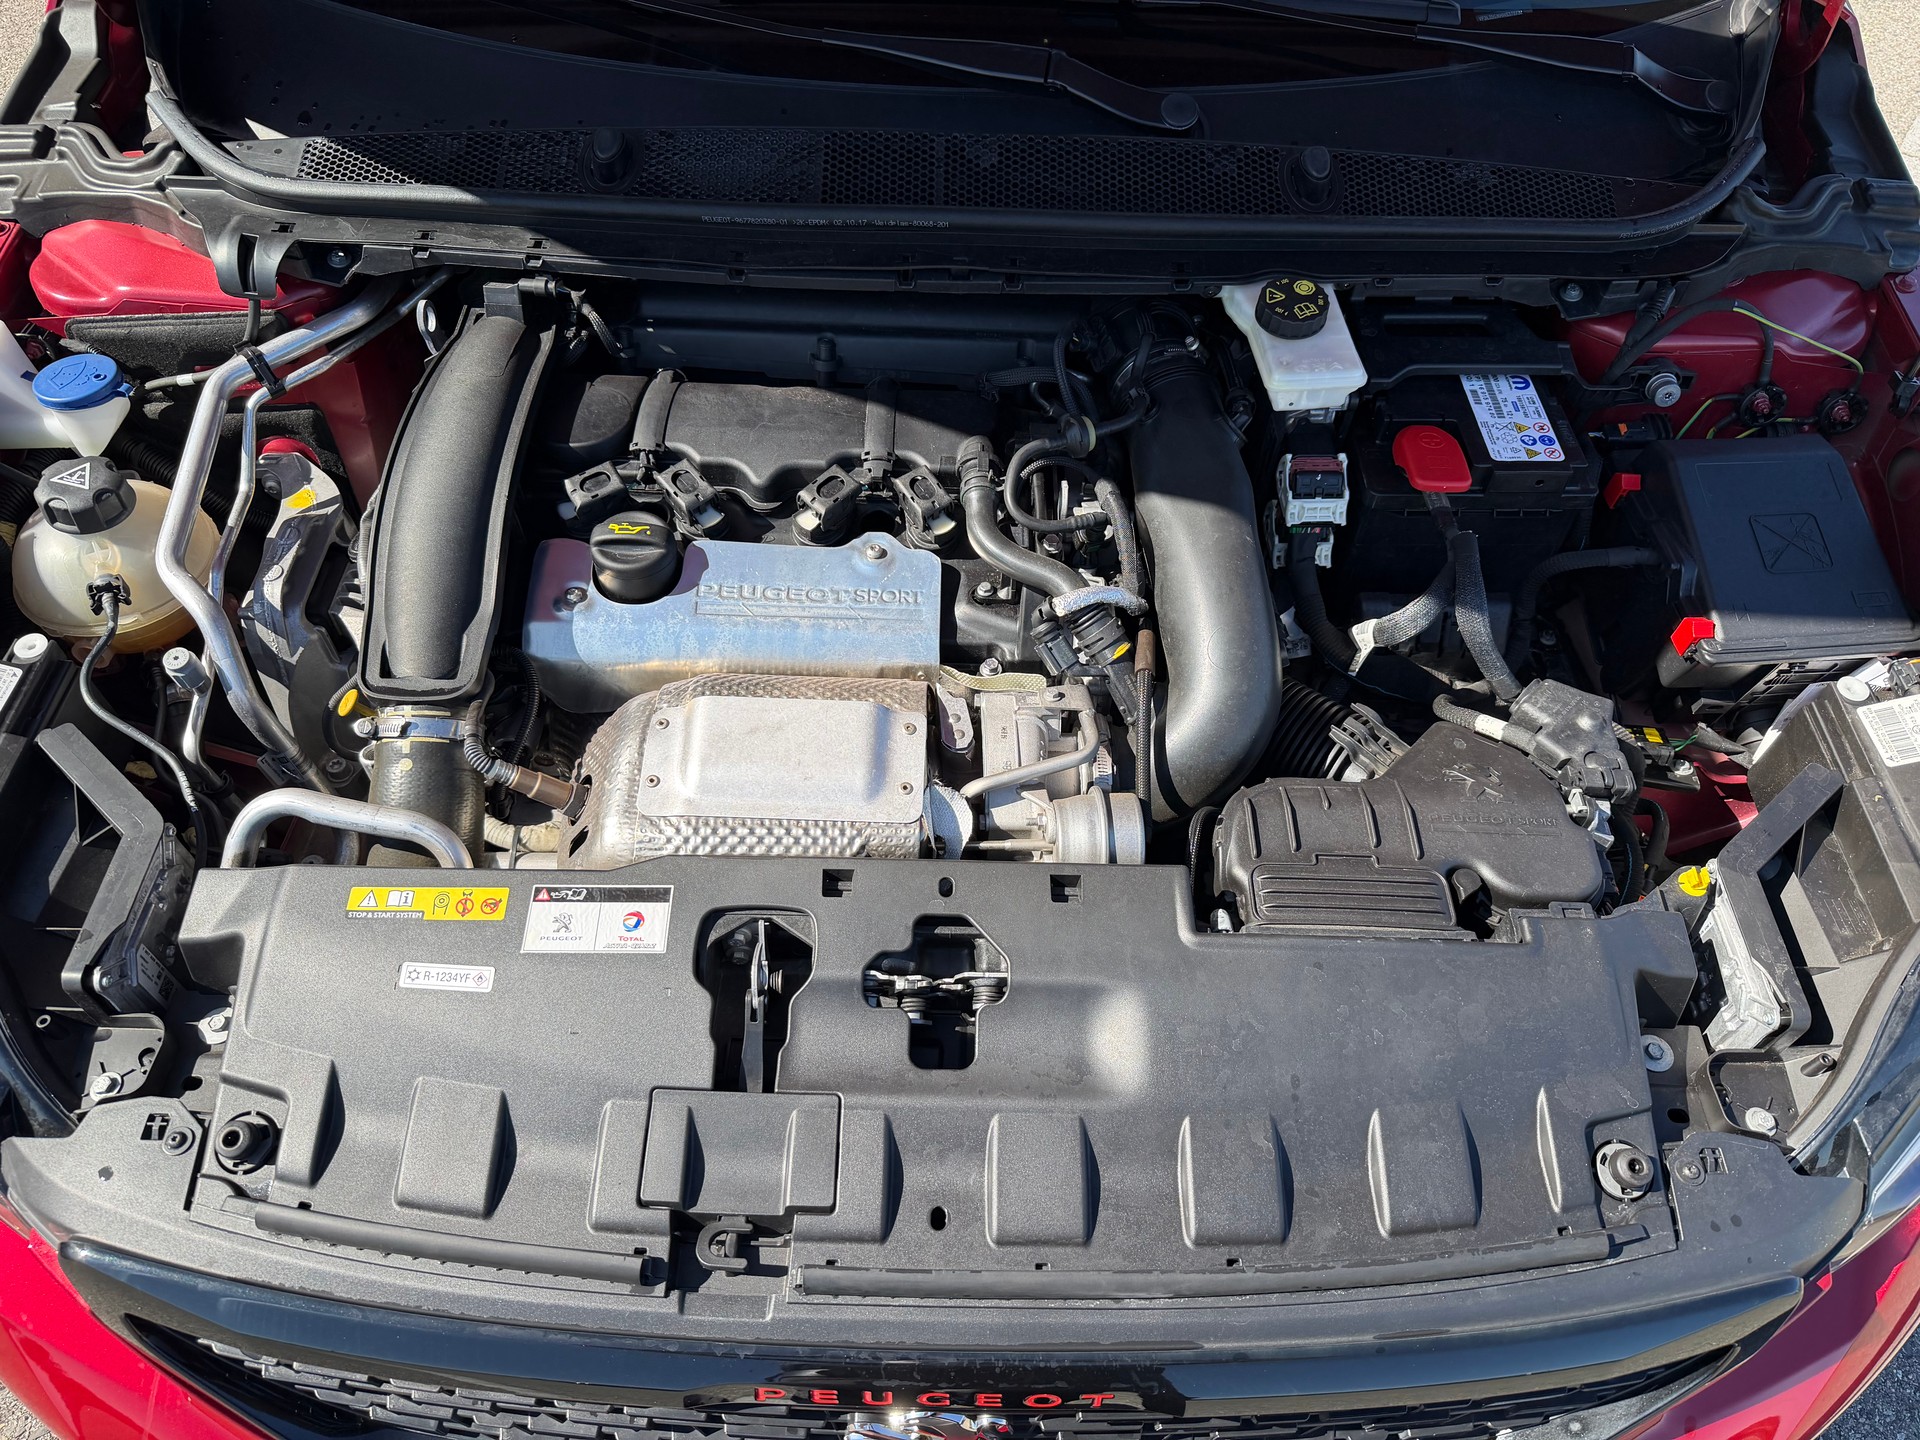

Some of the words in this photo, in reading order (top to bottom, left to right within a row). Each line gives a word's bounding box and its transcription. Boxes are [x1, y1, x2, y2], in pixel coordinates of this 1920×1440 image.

[697, 583, 849, 602] PEUGEOT
[853, 587, 923, 605] SPORT
[1429, 813, 1512, 824] PEUGEOT
[1519, 816, 1557, 827] SPORT
[347, 911, 367, 919] STOP
[367, 911, 374, 919] &
[423, 970, 471, 983] R-1234YF
[754, 1387, 1115, 1409] PEUGEOT
